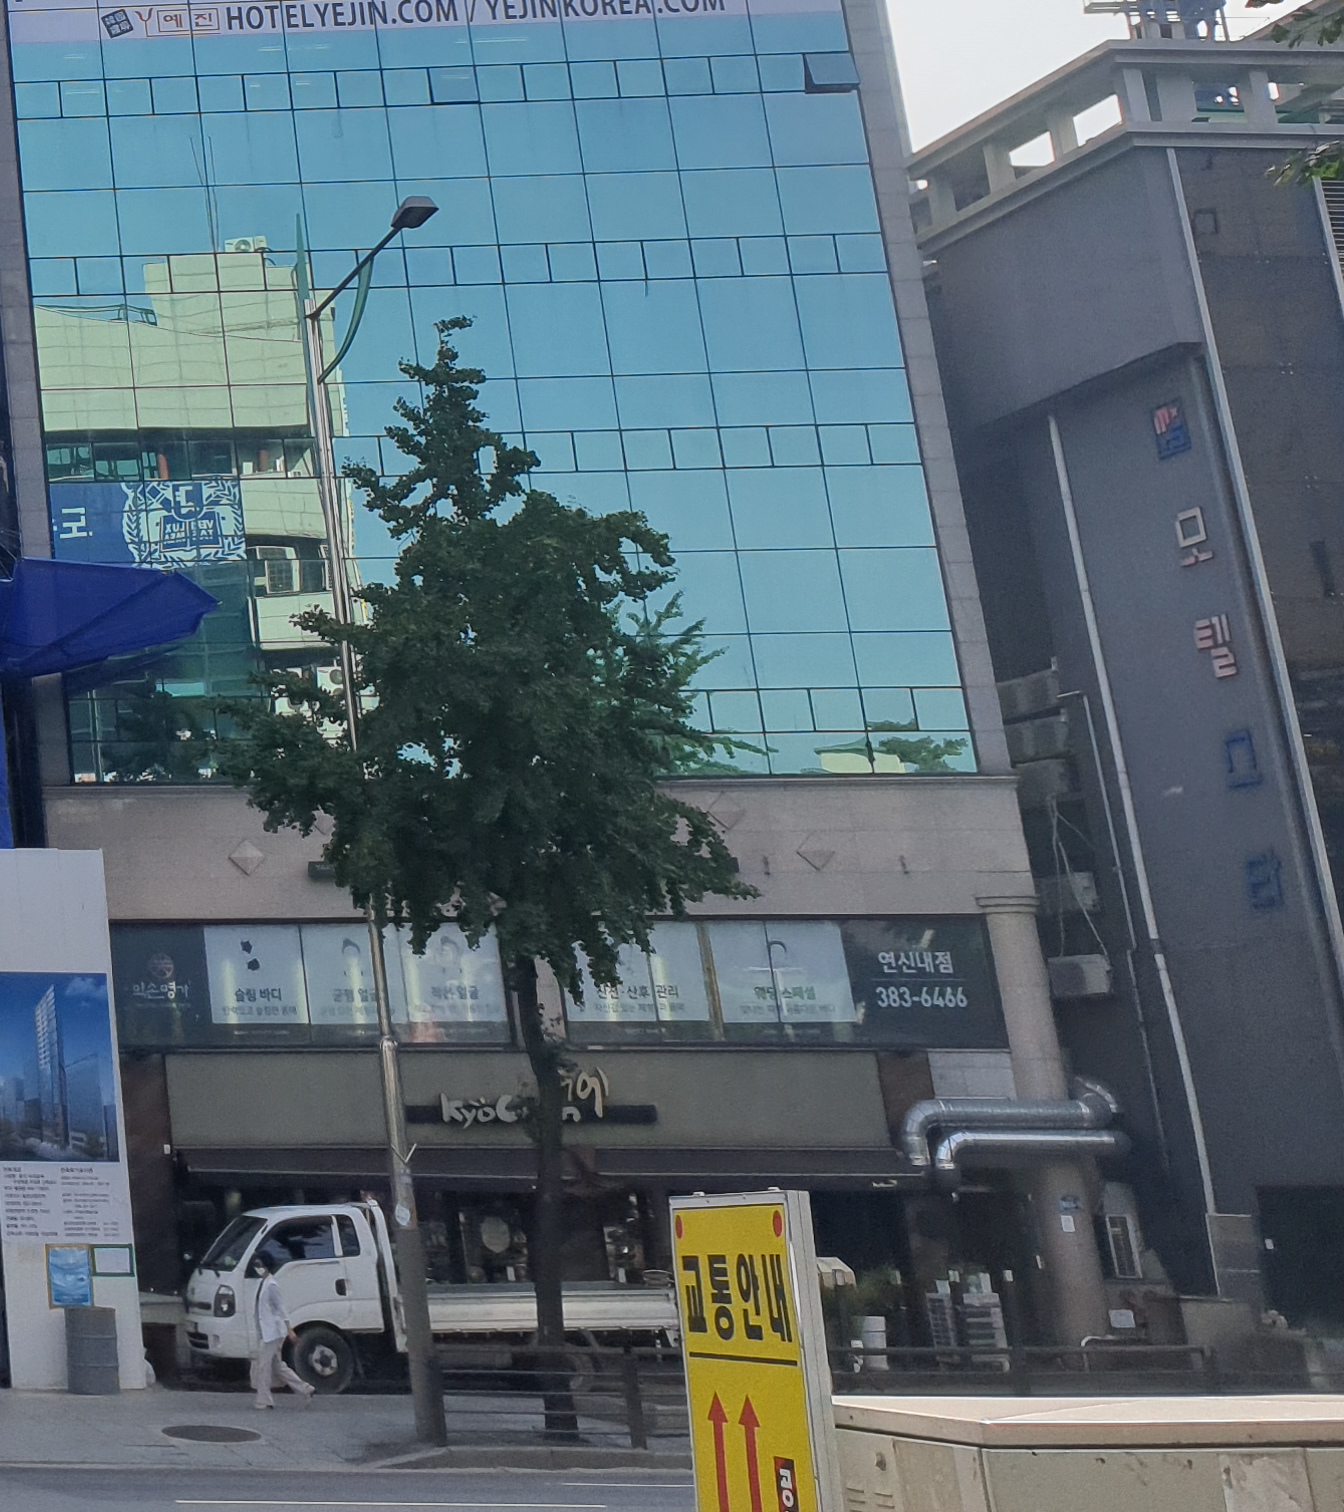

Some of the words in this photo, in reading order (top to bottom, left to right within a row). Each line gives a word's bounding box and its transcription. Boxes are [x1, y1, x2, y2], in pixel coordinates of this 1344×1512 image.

[877, 949, 955, 975] 연신내점
[876, 985, 968, 1009] 383-6466
[681, 1252, 794, 1343] 교통안내
